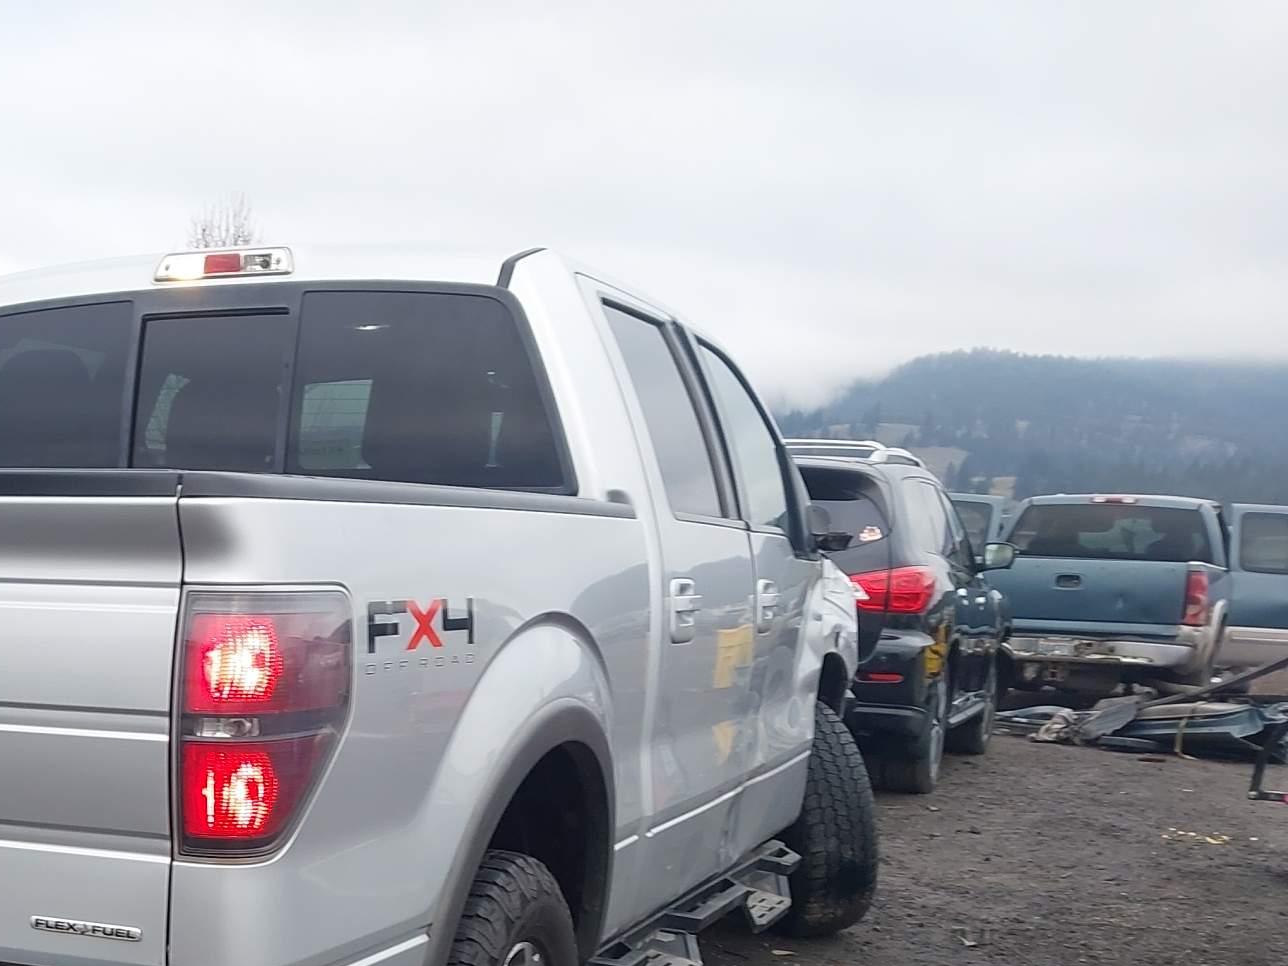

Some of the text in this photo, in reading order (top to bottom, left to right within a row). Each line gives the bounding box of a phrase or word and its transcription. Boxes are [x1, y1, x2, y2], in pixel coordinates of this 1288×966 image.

[367, 597, 474, 653] FX4
[34, 918, 137, 939] FLEX FUEL
